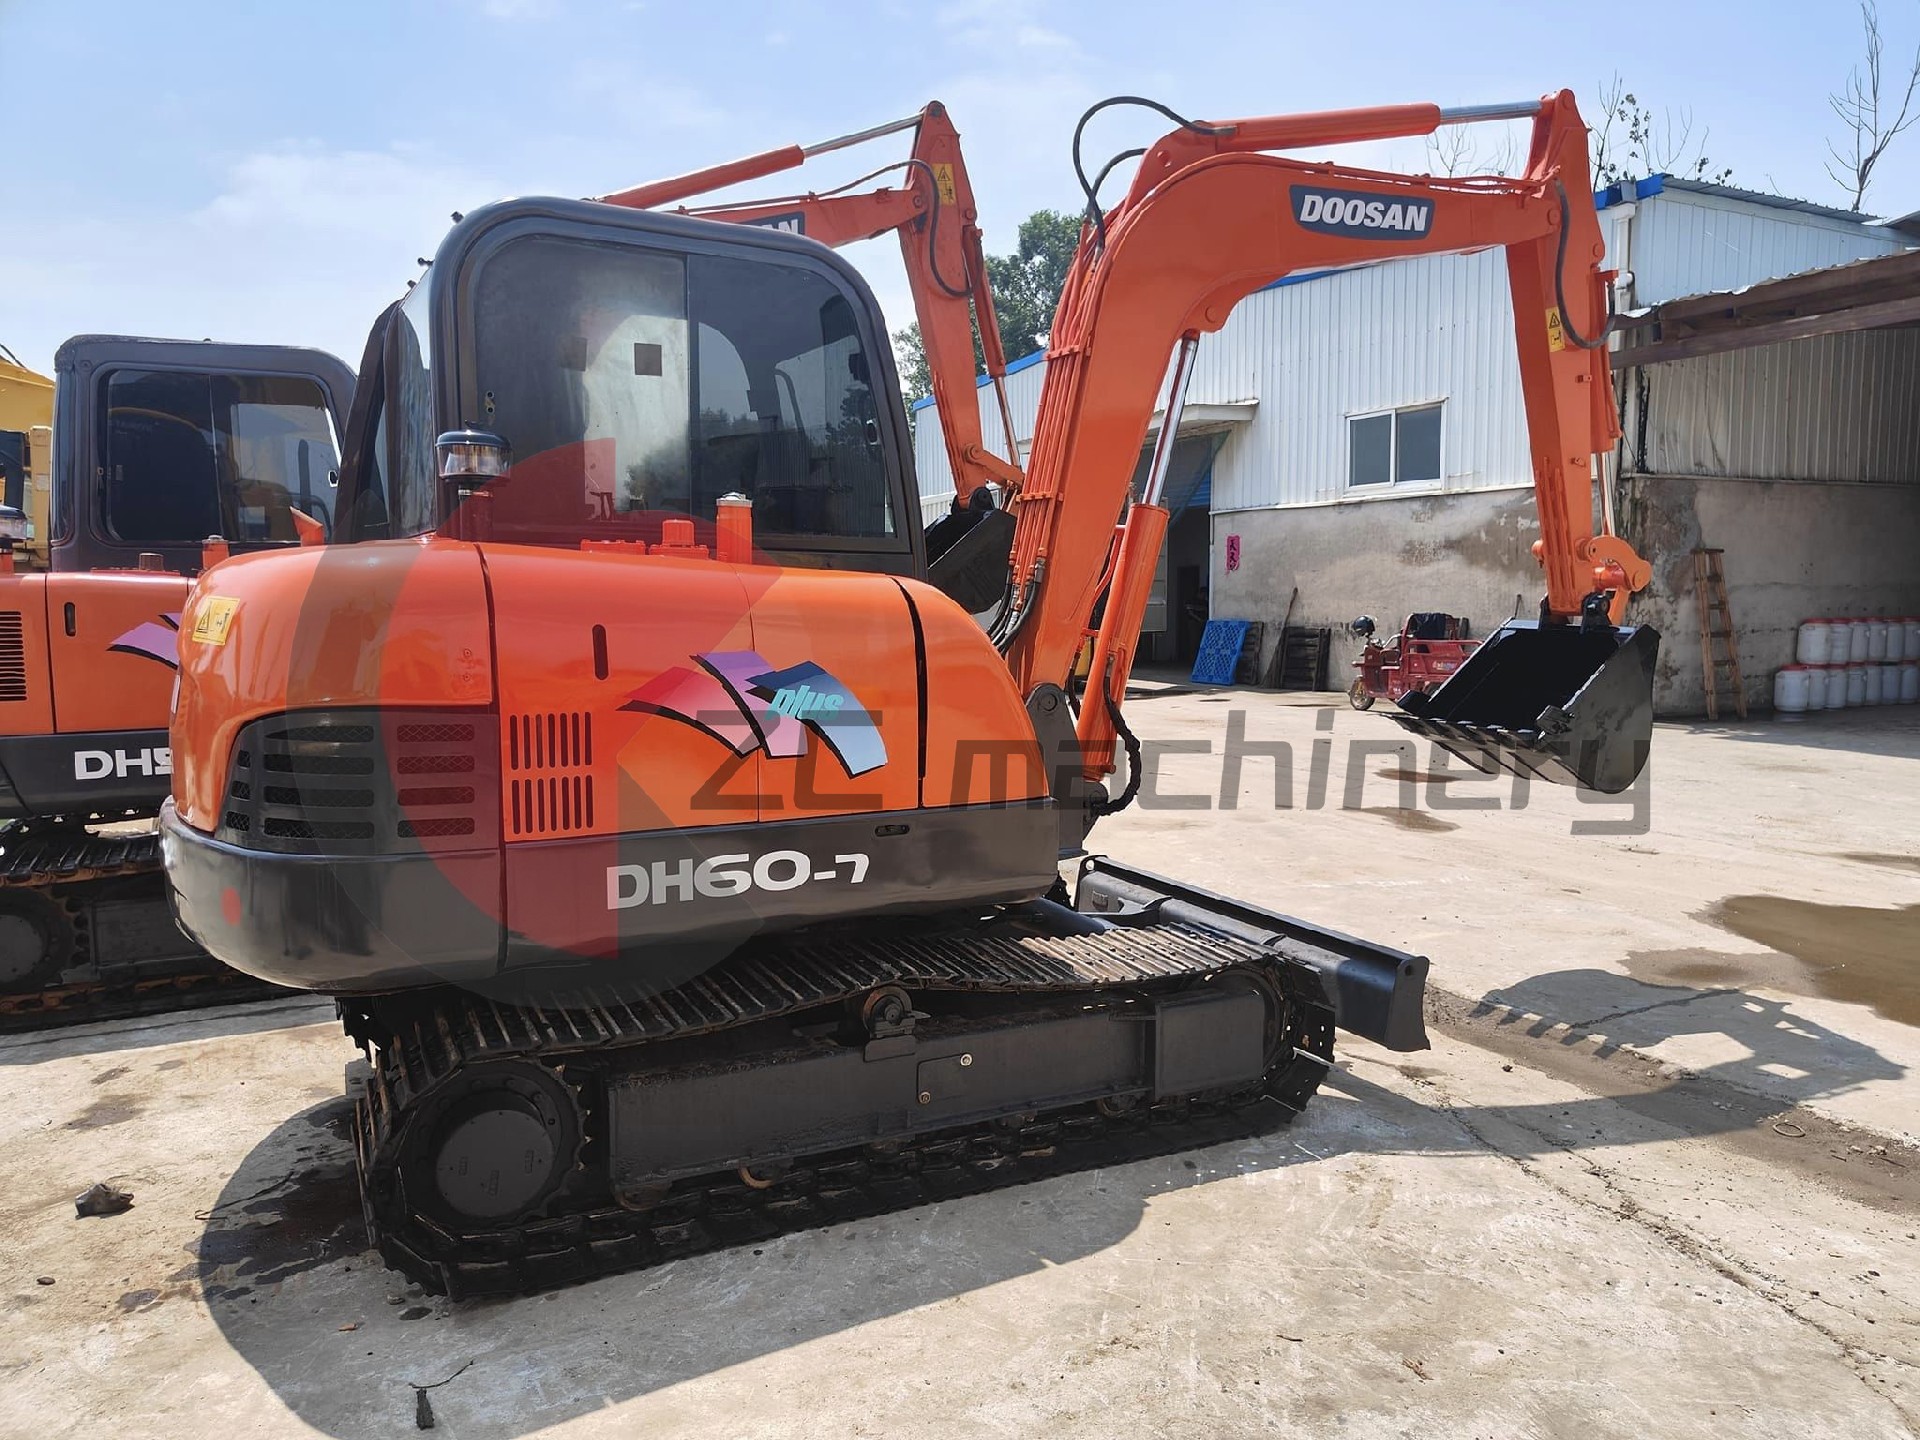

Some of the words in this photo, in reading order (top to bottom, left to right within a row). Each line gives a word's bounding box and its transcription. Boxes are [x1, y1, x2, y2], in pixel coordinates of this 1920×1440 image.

[1299, 194, 1429, 232] DOOSAN
[764, 684, 844, 720] plus
[606, 850, 870, 910] DH60-7
